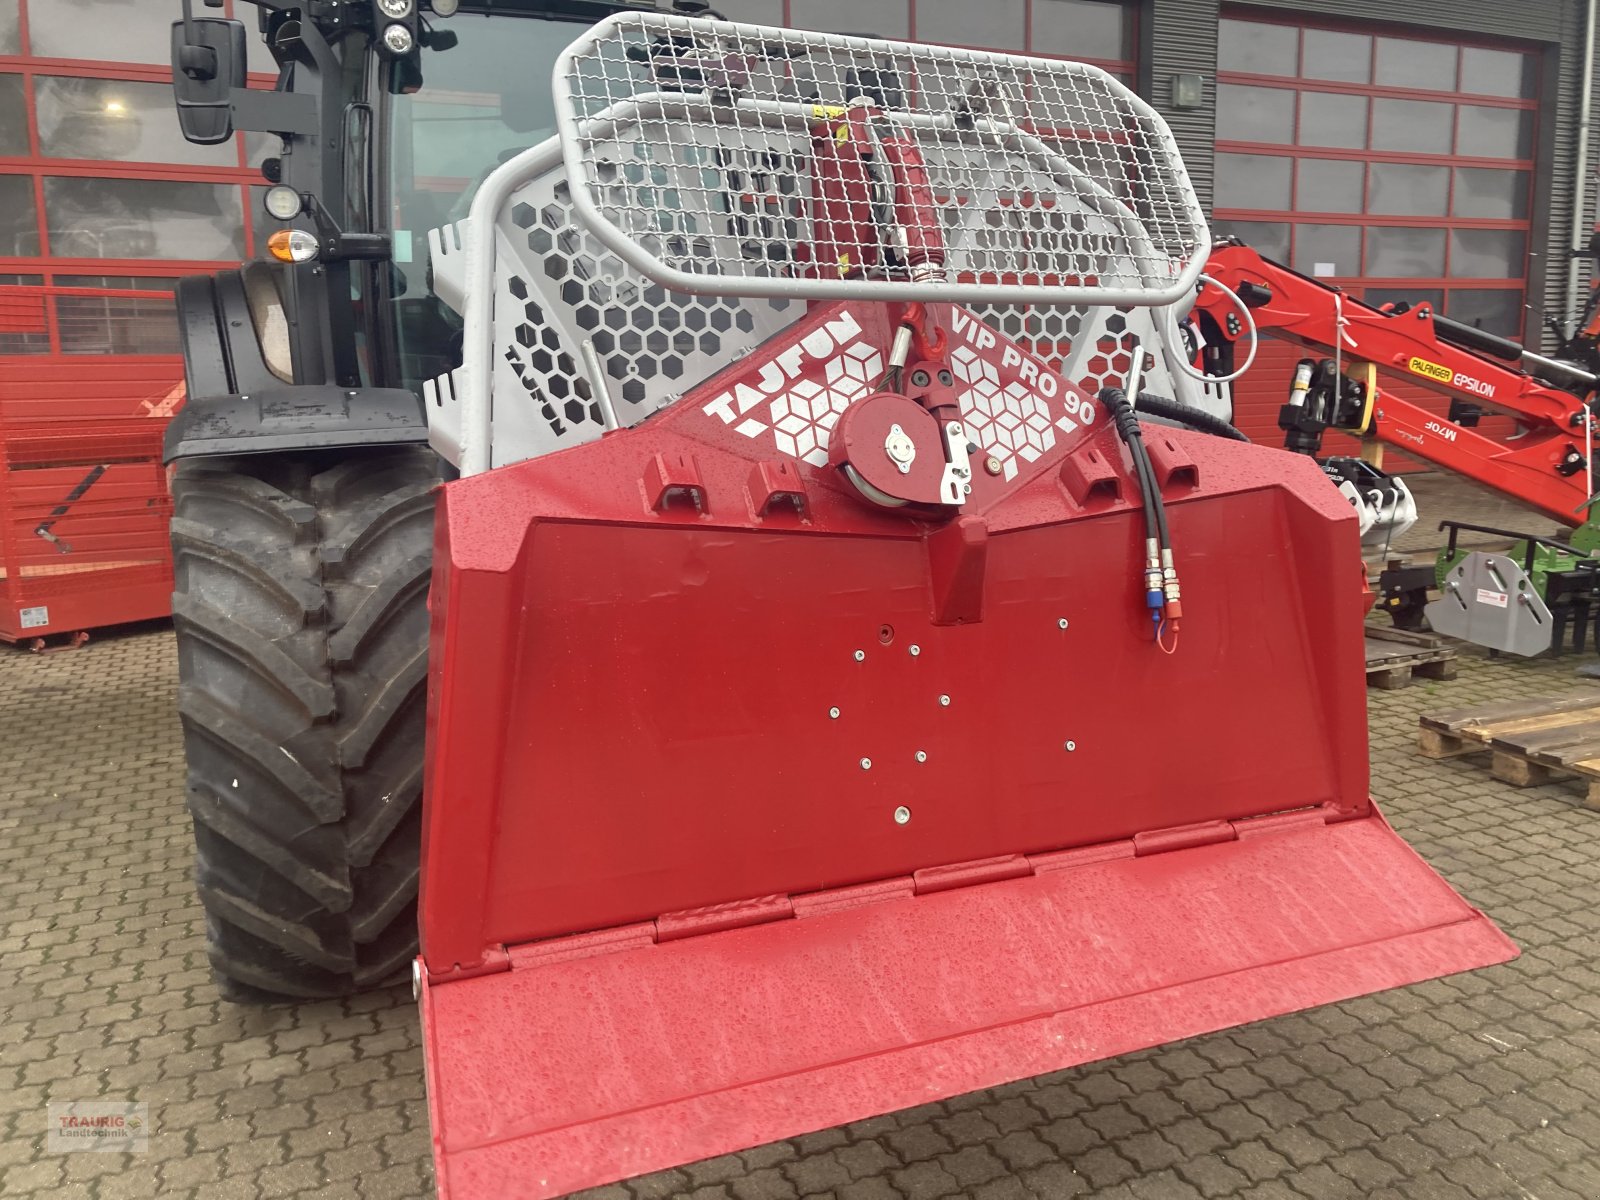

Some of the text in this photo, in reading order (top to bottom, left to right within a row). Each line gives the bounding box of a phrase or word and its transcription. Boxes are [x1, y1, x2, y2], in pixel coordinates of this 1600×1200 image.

[504, 344, 568, 437] TAJFUN
[702, 310, 862, 425] TAJFUN
[952, 305, 1096, 425] VIP PRO 90
[1411, 359, 1496, 397] PALFINGER EPSILON
[1424, 421, 1457, 442] M70F
